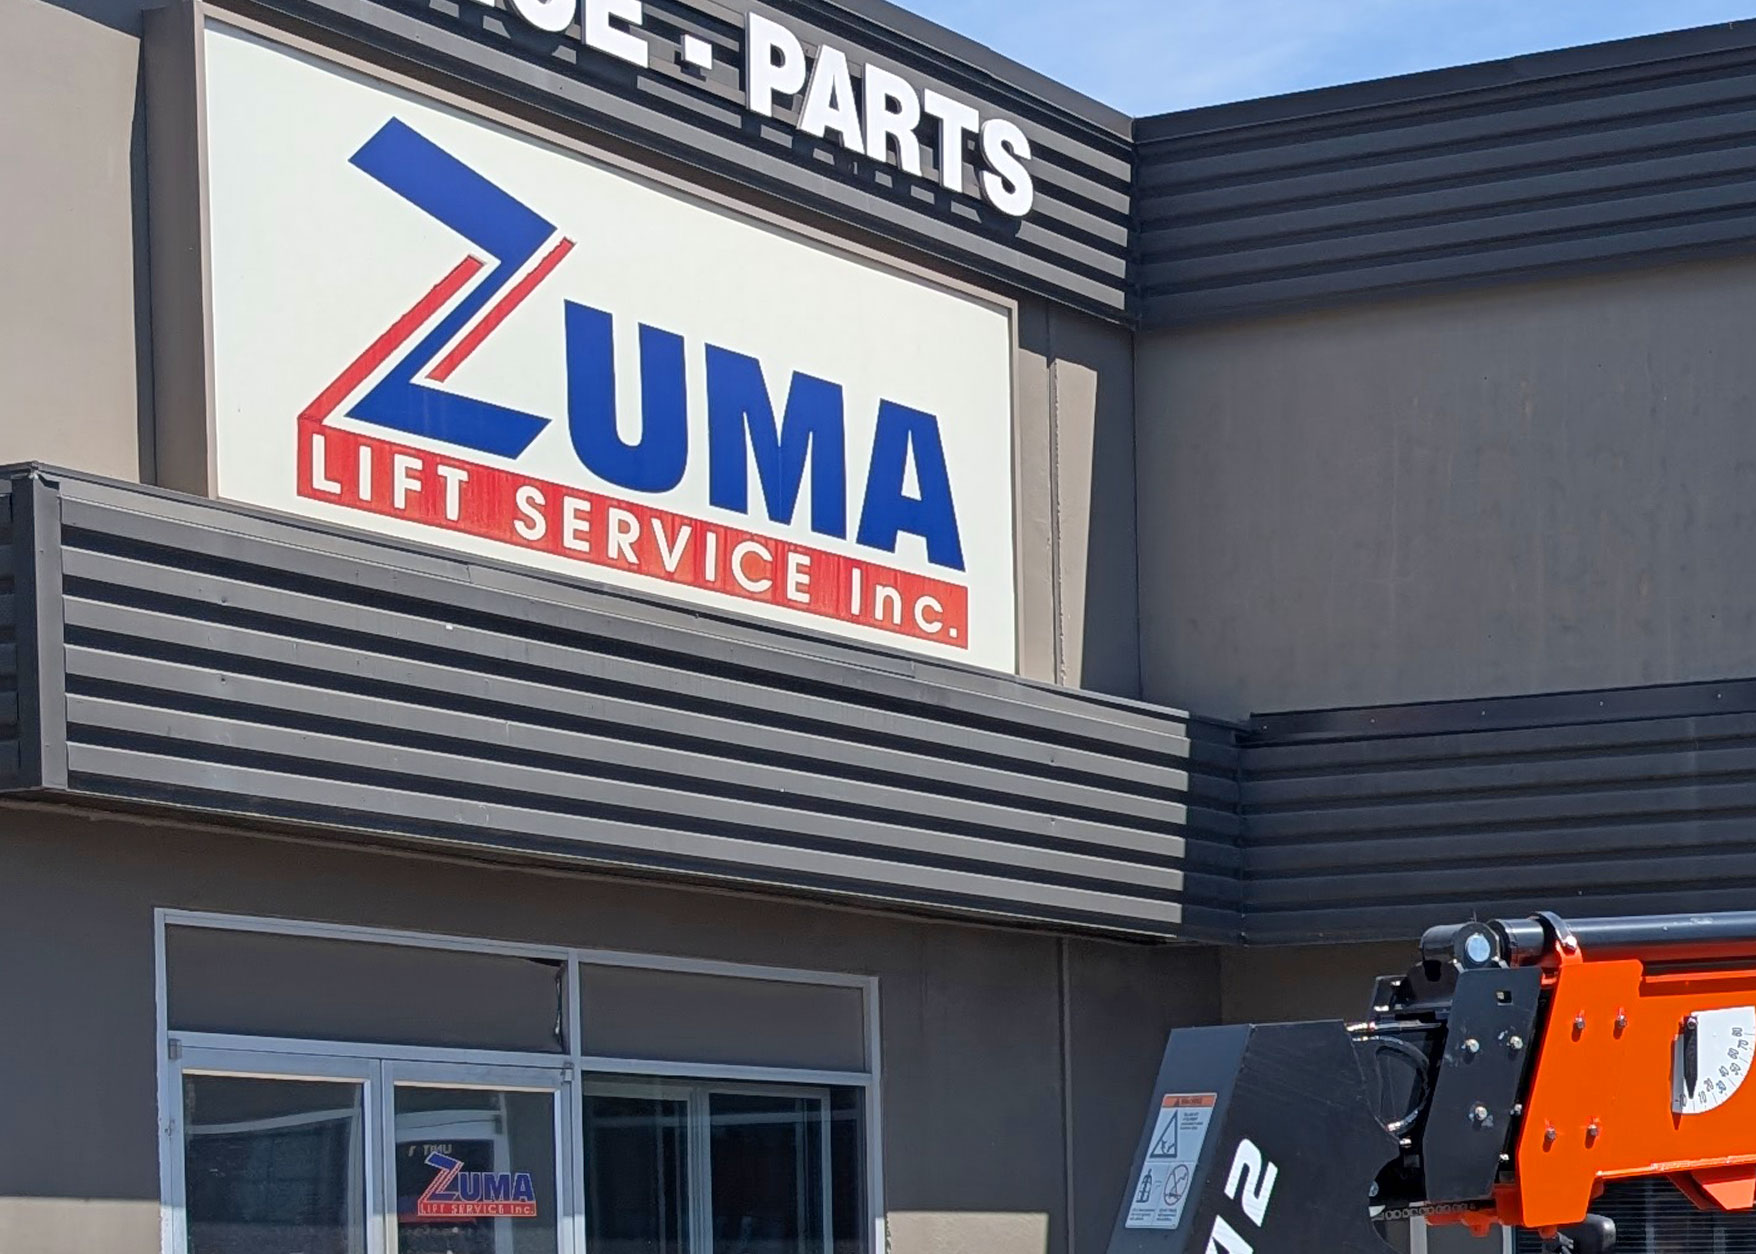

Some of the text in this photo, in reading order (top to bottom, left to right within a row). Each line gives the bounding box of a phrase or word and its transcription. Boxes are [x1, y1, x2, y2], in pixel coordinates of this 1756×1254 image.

[745, 12, 1033, 216] PARTS
[343, 116, 966, 572] ZUMA
[311, 433, 960, 638] LIFT SERVICE Inc.
[424, 1151, 536, 1202] ZUMA
[451, 1203, 505, 1214] SERVICE
